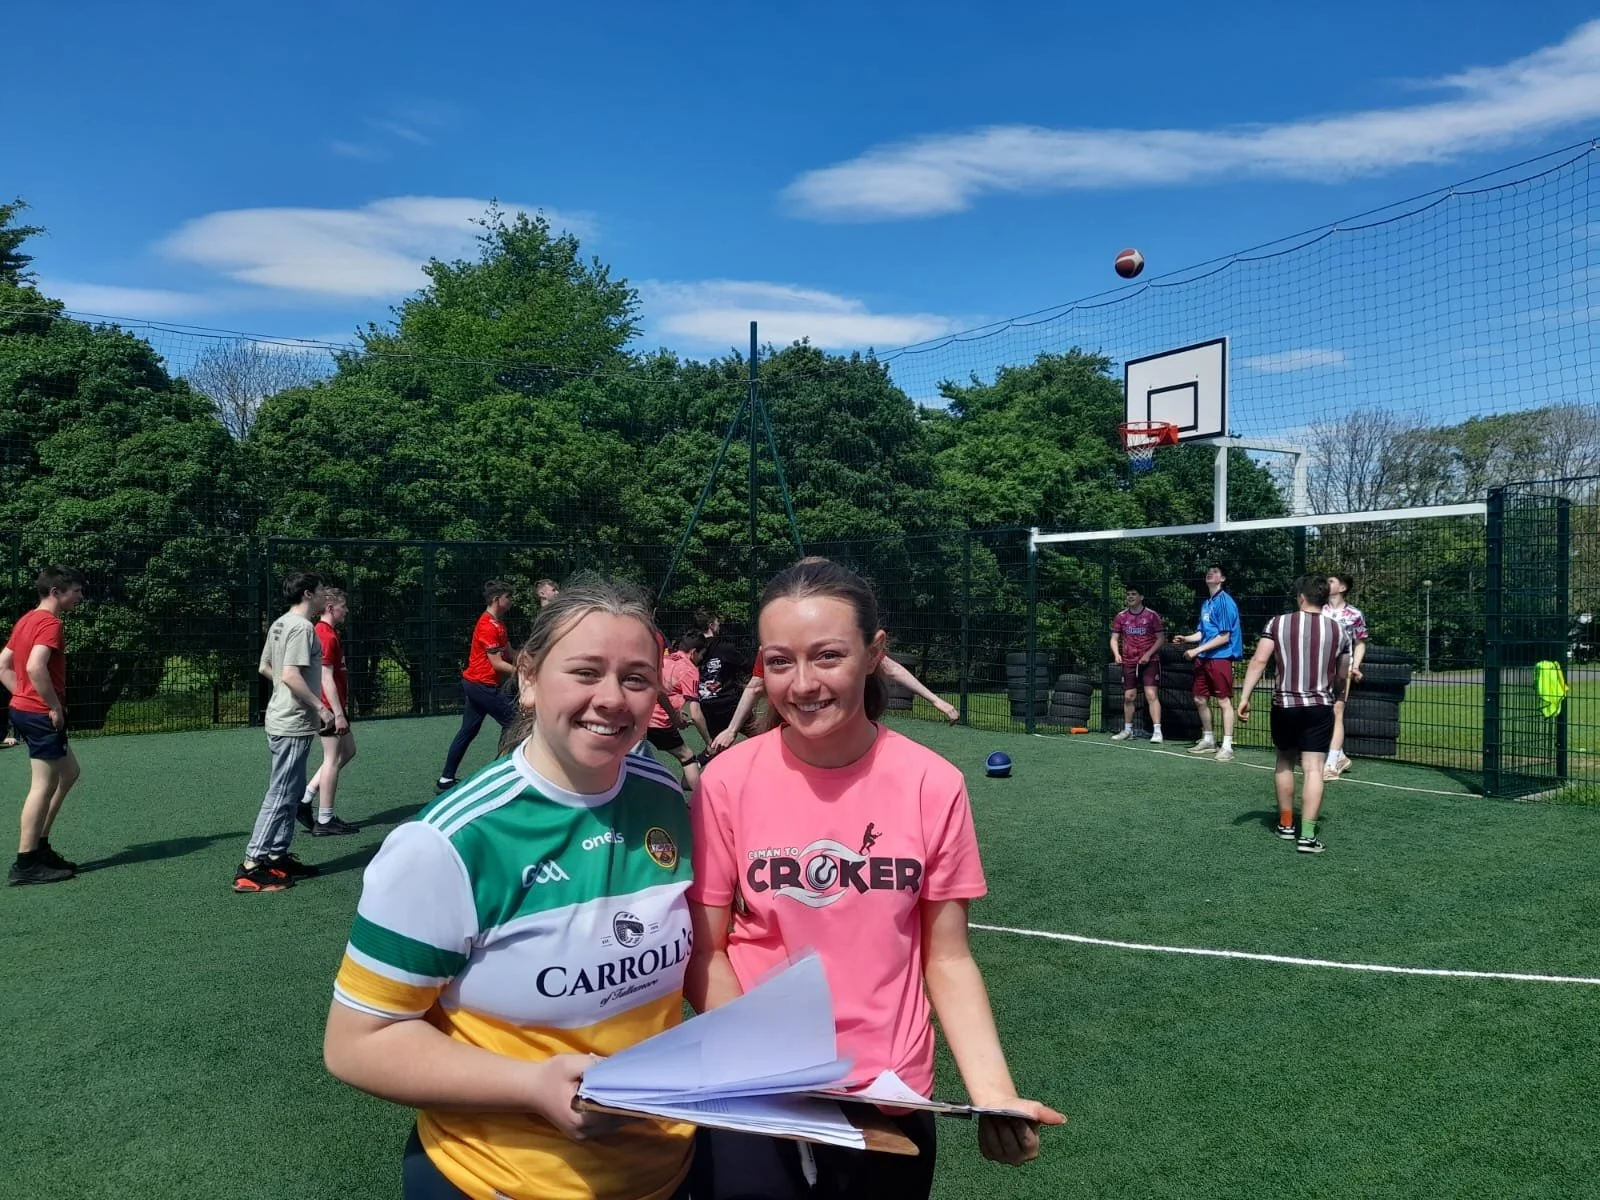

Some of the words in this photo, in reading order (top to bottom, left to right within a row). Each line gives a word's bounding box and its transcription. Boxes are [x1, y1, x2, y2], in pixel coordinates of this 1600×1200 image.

[784, 847, 799, 856] TO
[747, 857, 922, 895] CROKER
[600, 991, 615, 1008] of
